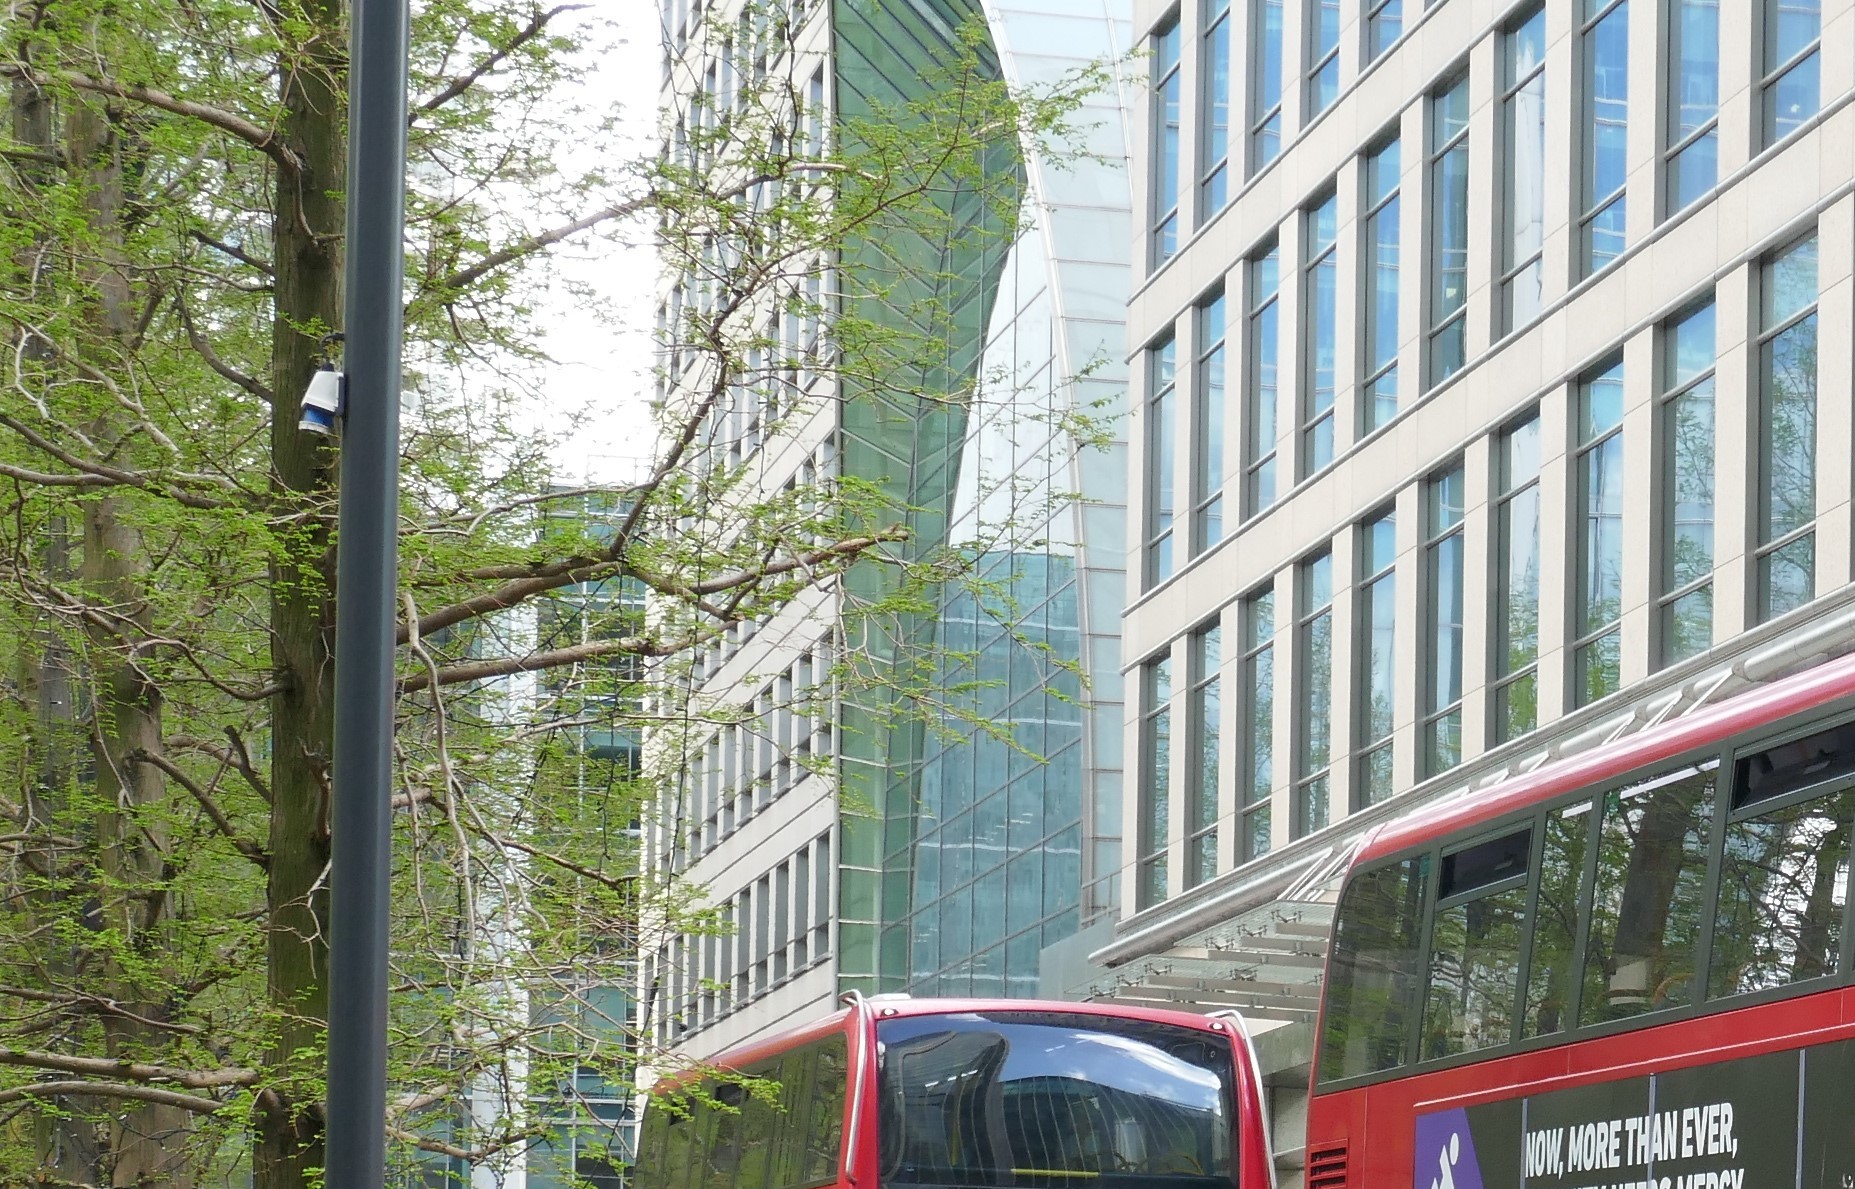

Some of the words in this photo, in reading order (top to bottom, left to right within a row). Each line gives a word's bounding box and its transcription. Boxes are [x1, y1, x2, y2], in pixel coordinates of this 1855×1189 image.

[1525, 1128, 1564, 1180] NOW,
[1567, 1120, 1622, 1173] MORE
[1625, 1110, 1677, 1166] THAN
[1681, 1102, 1738, 1159] EVER,
